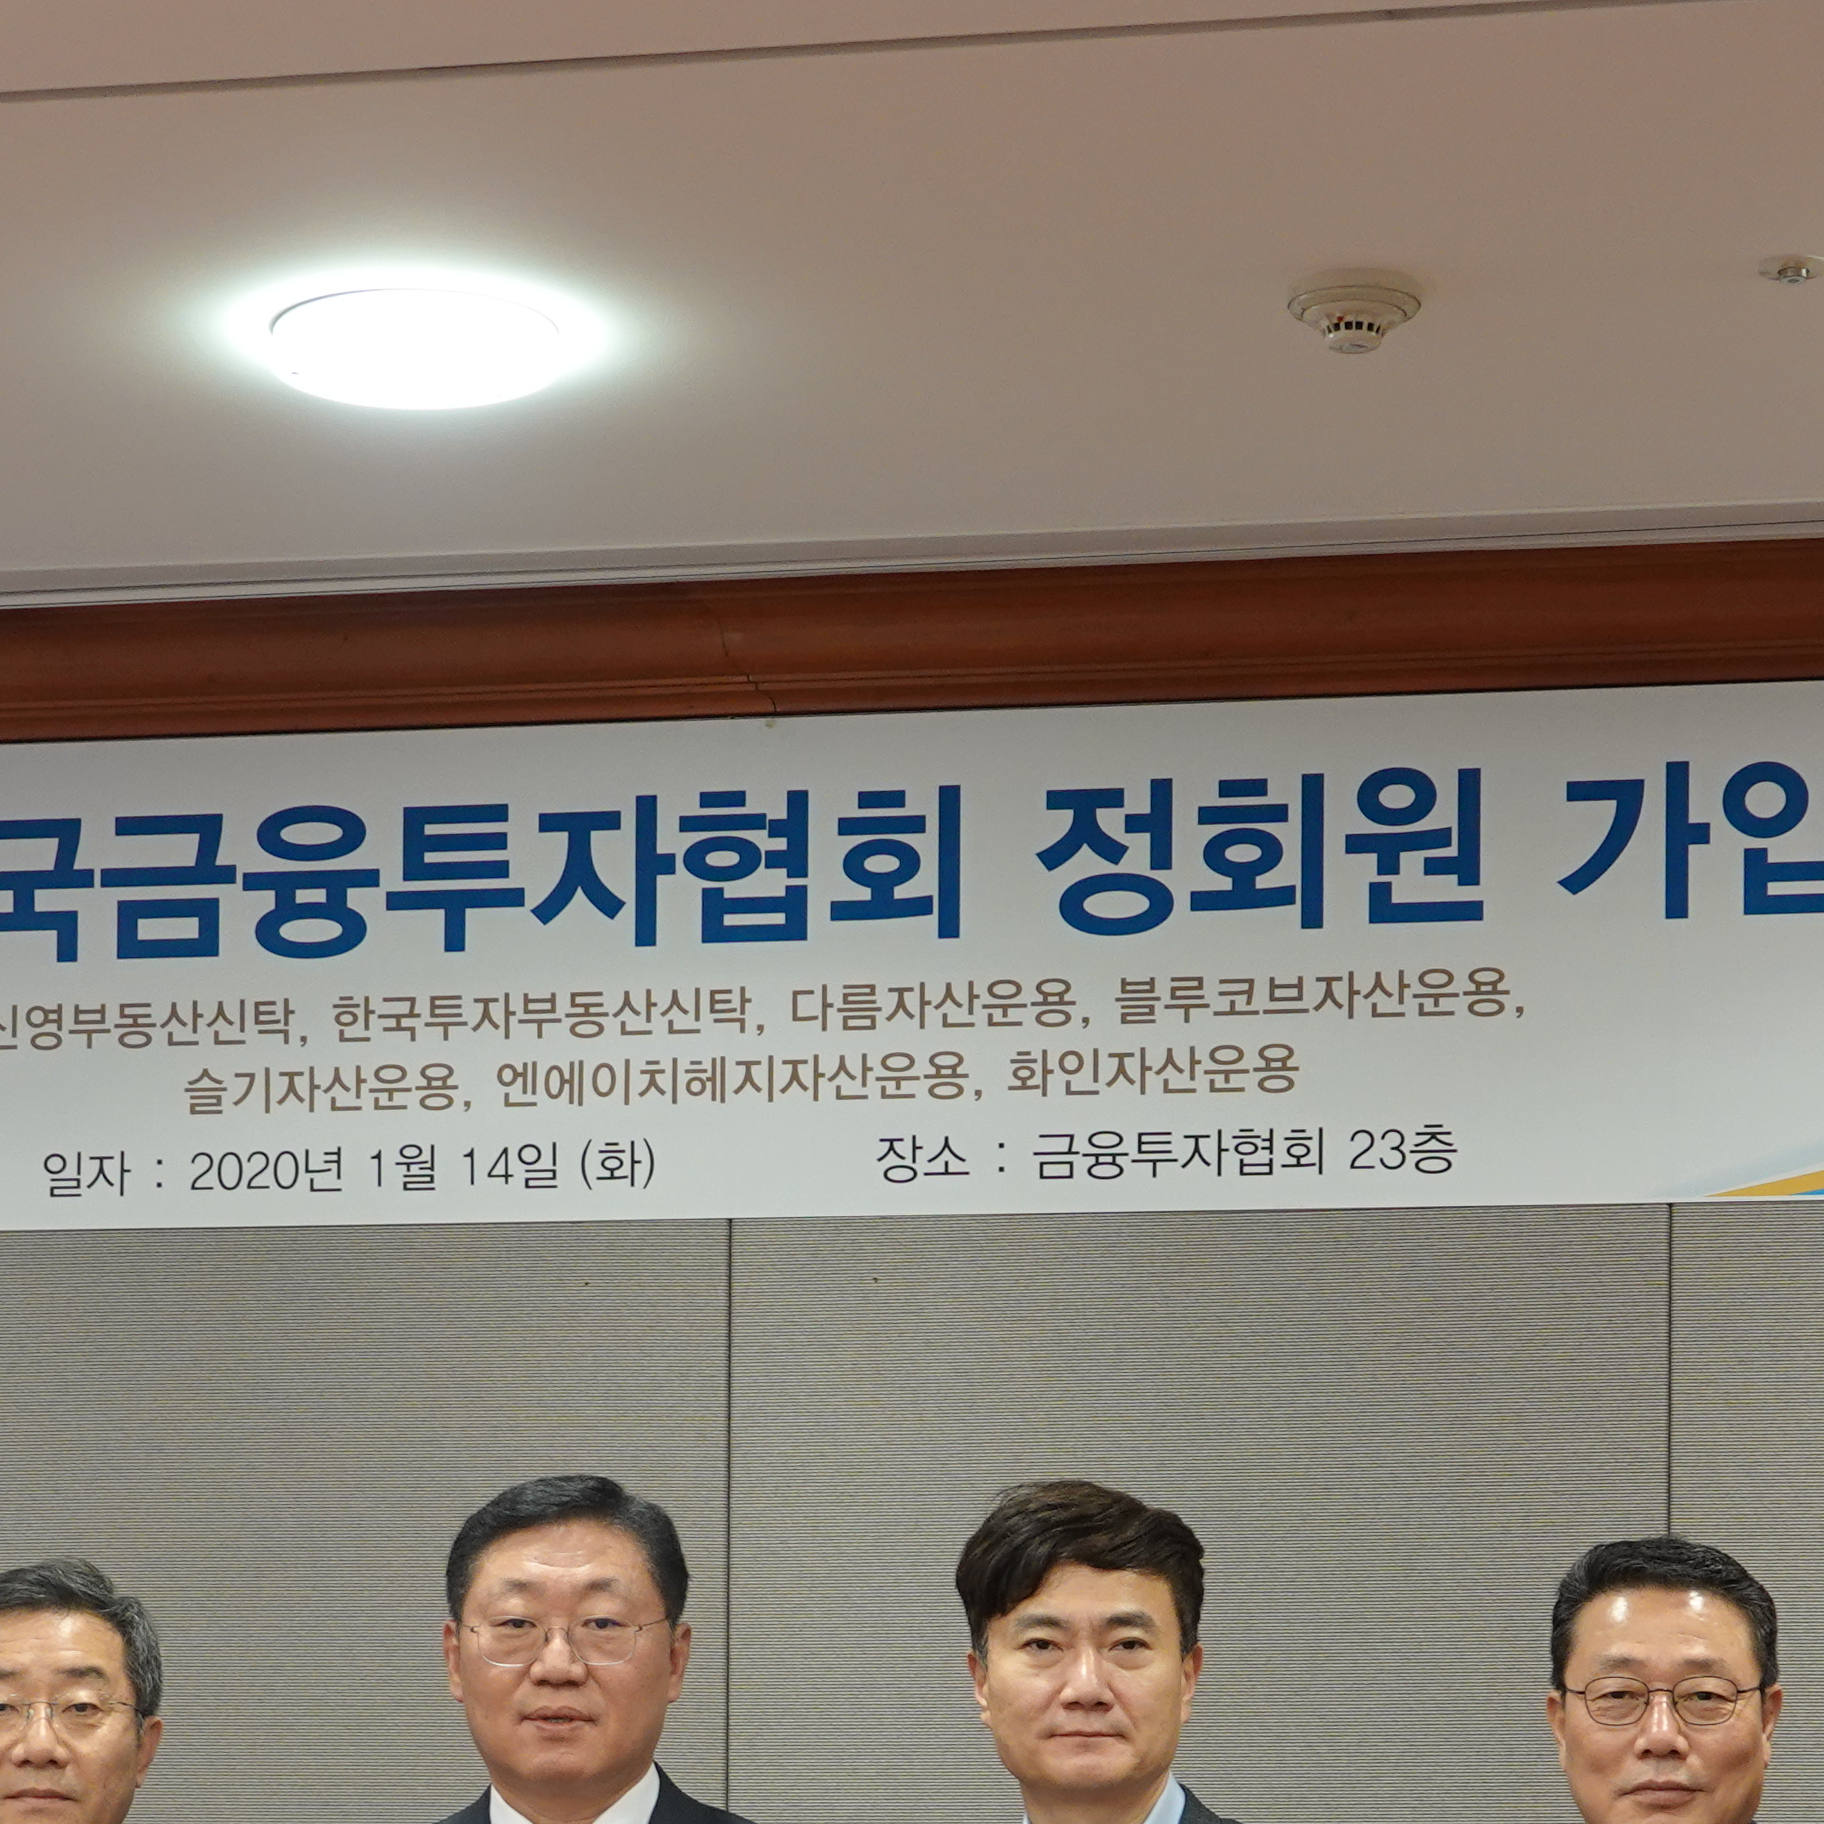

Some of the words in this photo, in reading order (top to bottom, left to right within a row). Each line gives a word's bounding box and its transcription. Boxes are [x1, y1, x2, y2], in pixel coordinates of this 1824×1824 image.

[1035, 766, 1484, 937] 정회원
[331, 985, 765, 1043] 한국투자부동산신탁,
[791, 977, 1090, 1032] 다름자산운용,
[1114, 966, 1524, 1025] 블루코브자산운용,
[183, 1062, 472, 1116] 슬기자산운용,
[496, 1050, 983, 1108] 엔에이치헤지자산운용,
[1007, 1043, 1300, 1098] 화인자산운용
[42, 1150, 132, 1198] 일자
[190, 1146, 344, 1194] 2020년
[370, 1143, 437, 1192] 1월
[463, 1141, 559, 1190] 14일
[580, 1137, 656, 1191] (화)
[875, 1134, 971, 1184] 장소
[1032, 1126, 1325, 1180] 금융투자협회
[1349, 1124, 1459, 1175] 23층
